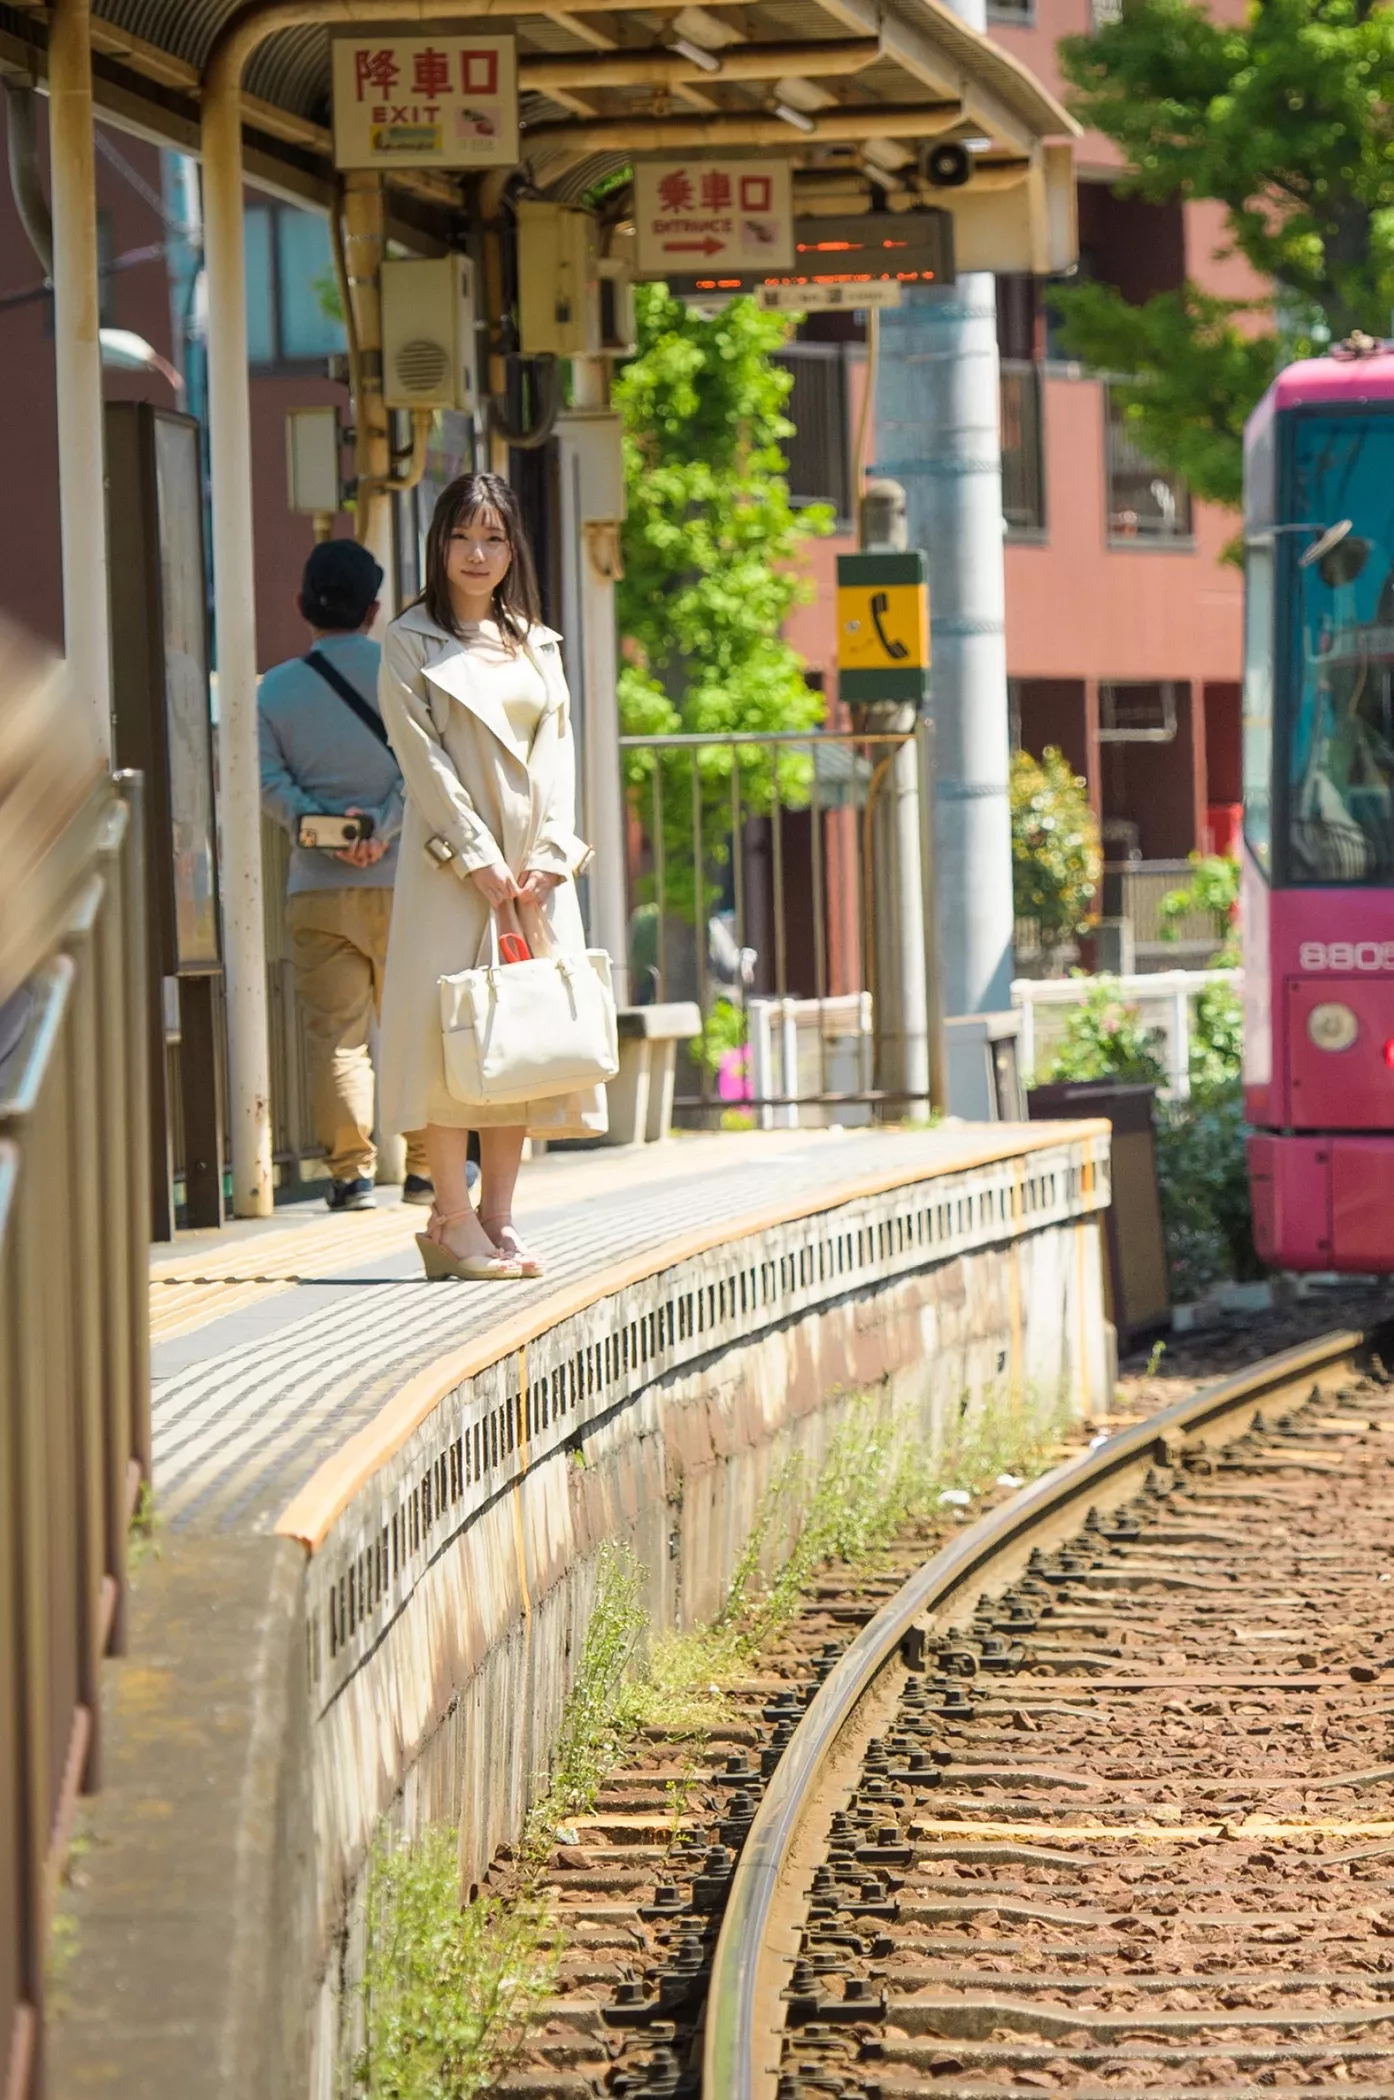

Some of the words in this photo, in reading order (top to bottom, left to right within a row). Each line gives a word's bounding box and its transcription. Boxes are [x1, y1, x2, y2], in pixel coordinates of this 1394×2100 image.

[354, 47, 499, 102] 降車口
[372, 106, 440, 124] EXIT
[656, 167, 773, 214] 乗車口
